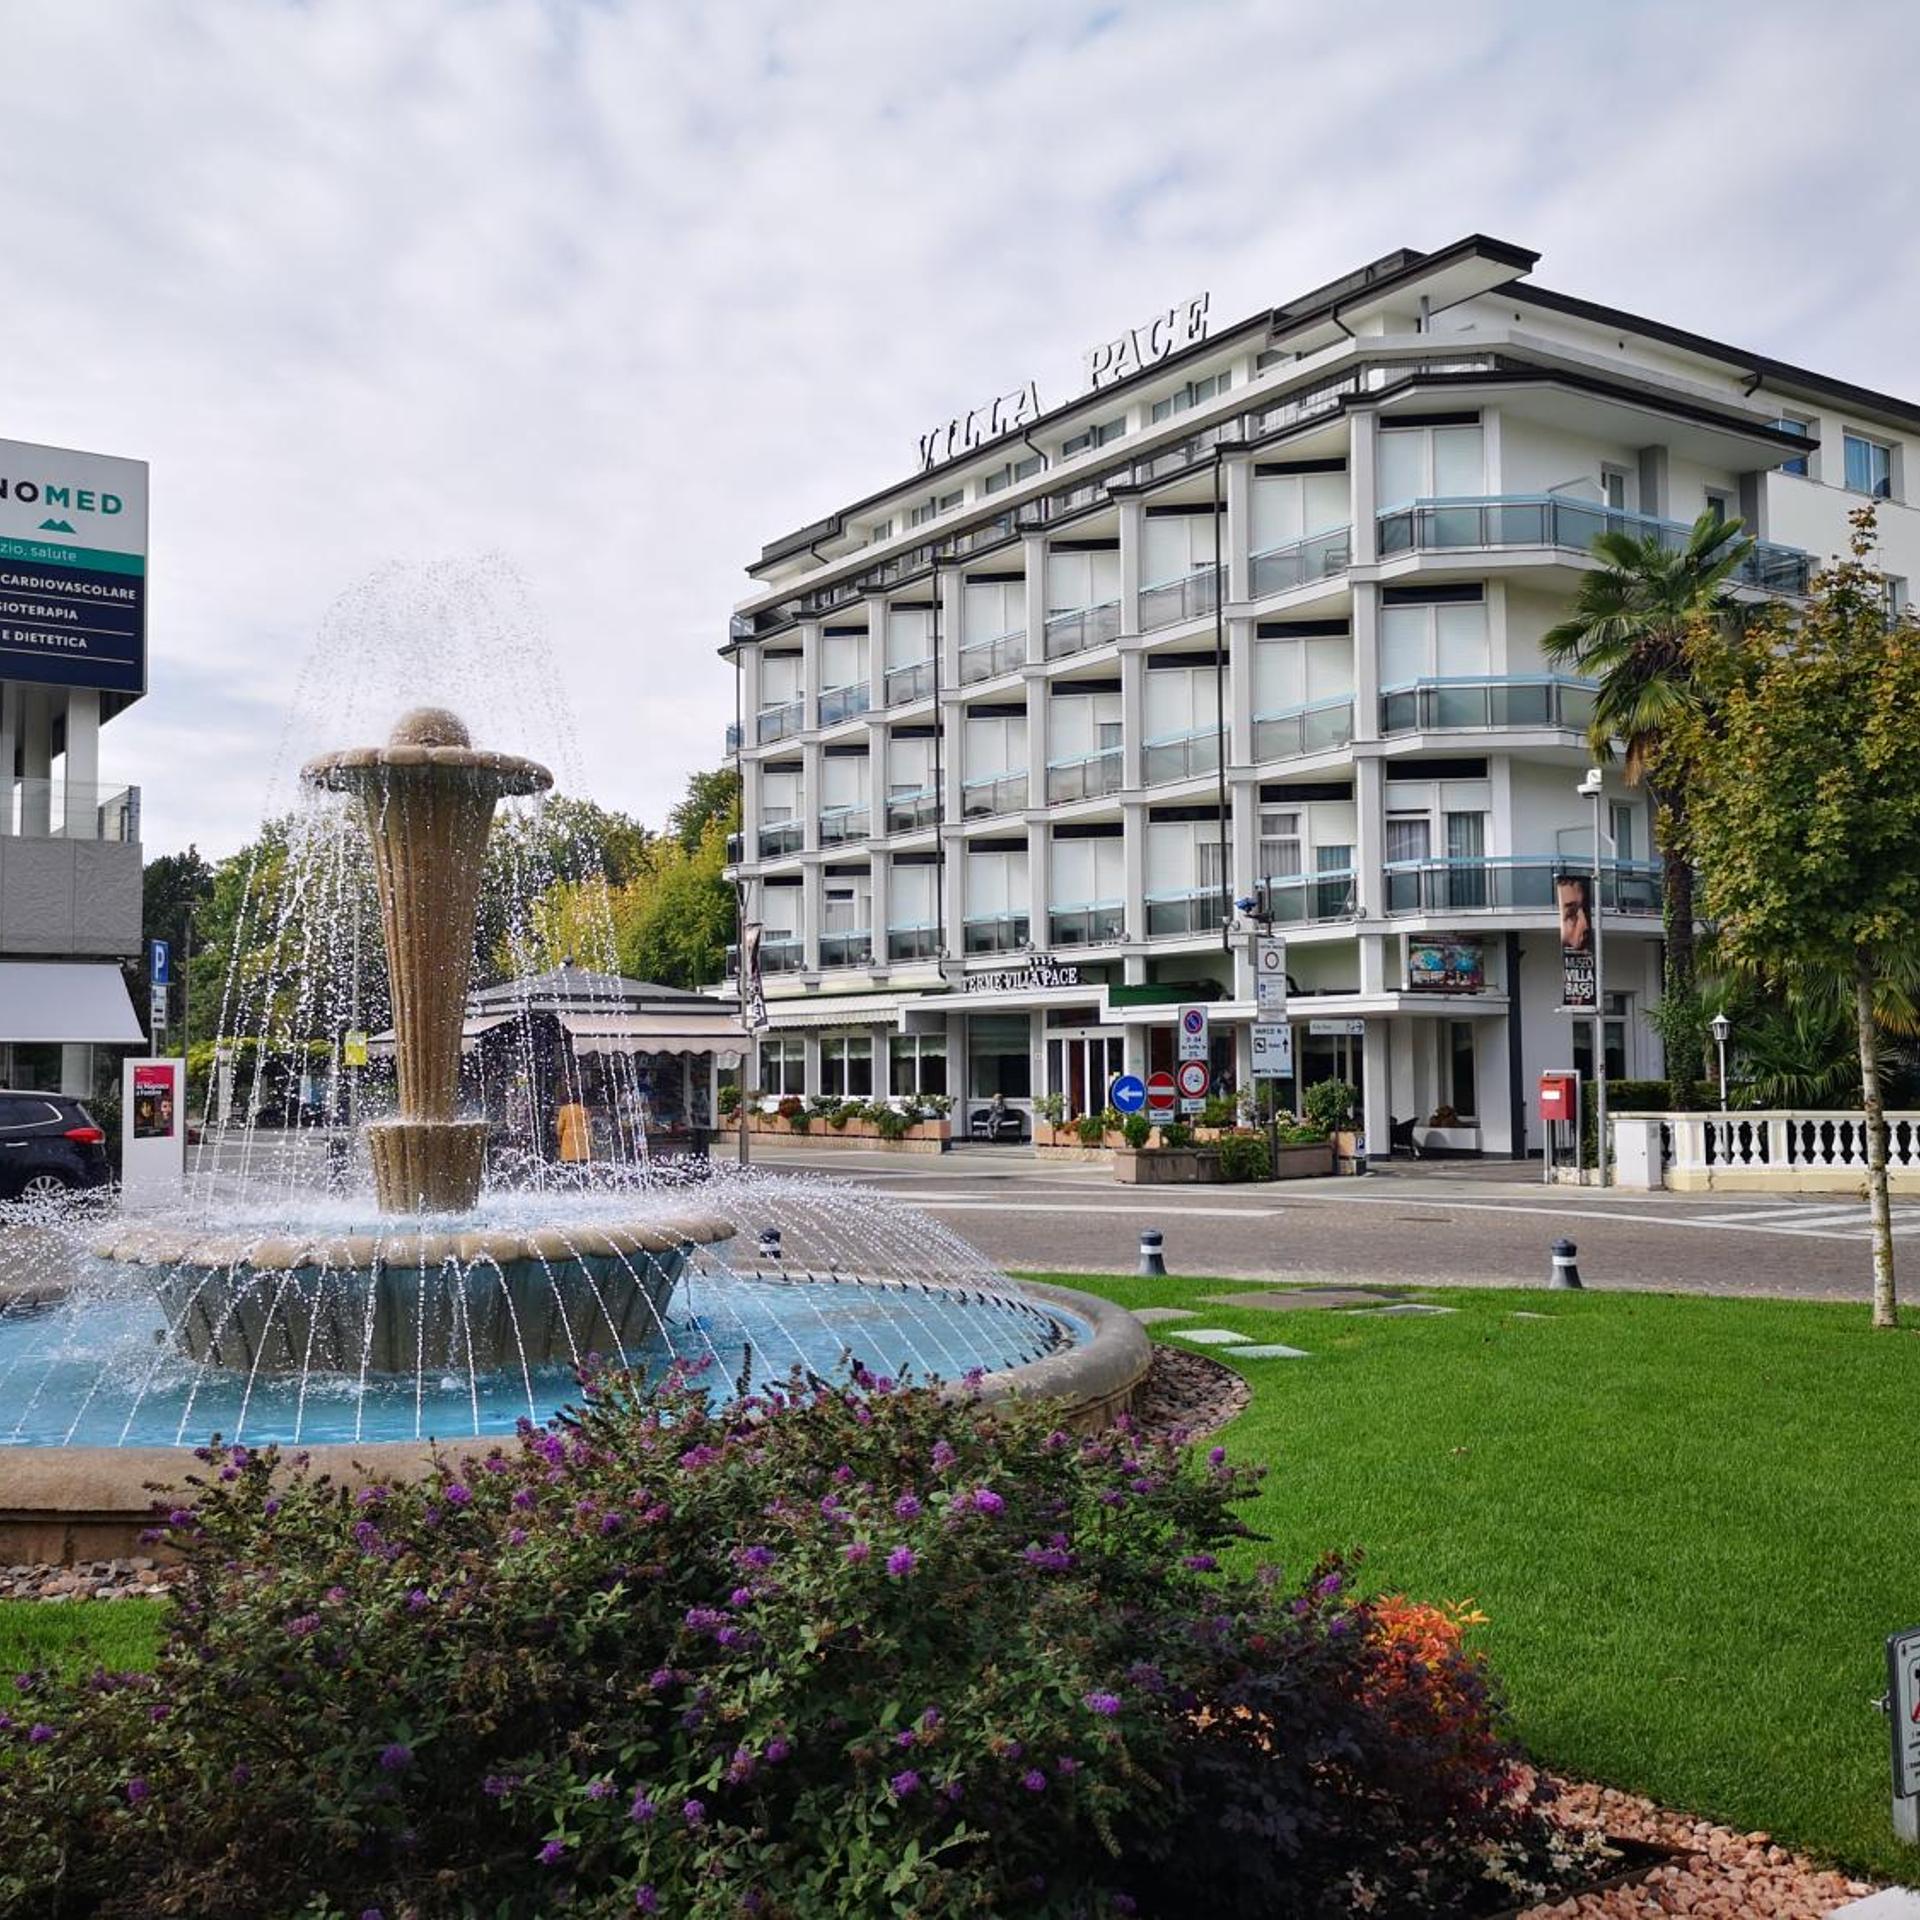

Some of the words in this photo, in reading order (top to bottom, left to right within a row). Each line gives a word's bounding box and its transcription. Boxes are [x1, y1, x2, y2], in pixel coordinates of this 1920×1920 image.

[912, 381, 1043, 471] VILLA
[1086, 292, 1210, 389] PACE
[30, 546, 77, 562] salute
[1, 573, 137, 600] CARDIOVASCOLARE
[2, 629, 10, 640] E
[14, 630, 88, 648] DIETETICA
[155, 944, 165, 979] P
[961, 974, 1006, 993] TERME
[1005, 970, 1041, 989] VILLA
[1044, 967, 1077, 986] PACE
[1565, 969, 1594, 982] VILLA
[1565, 982, 1594, 999] BASSI
